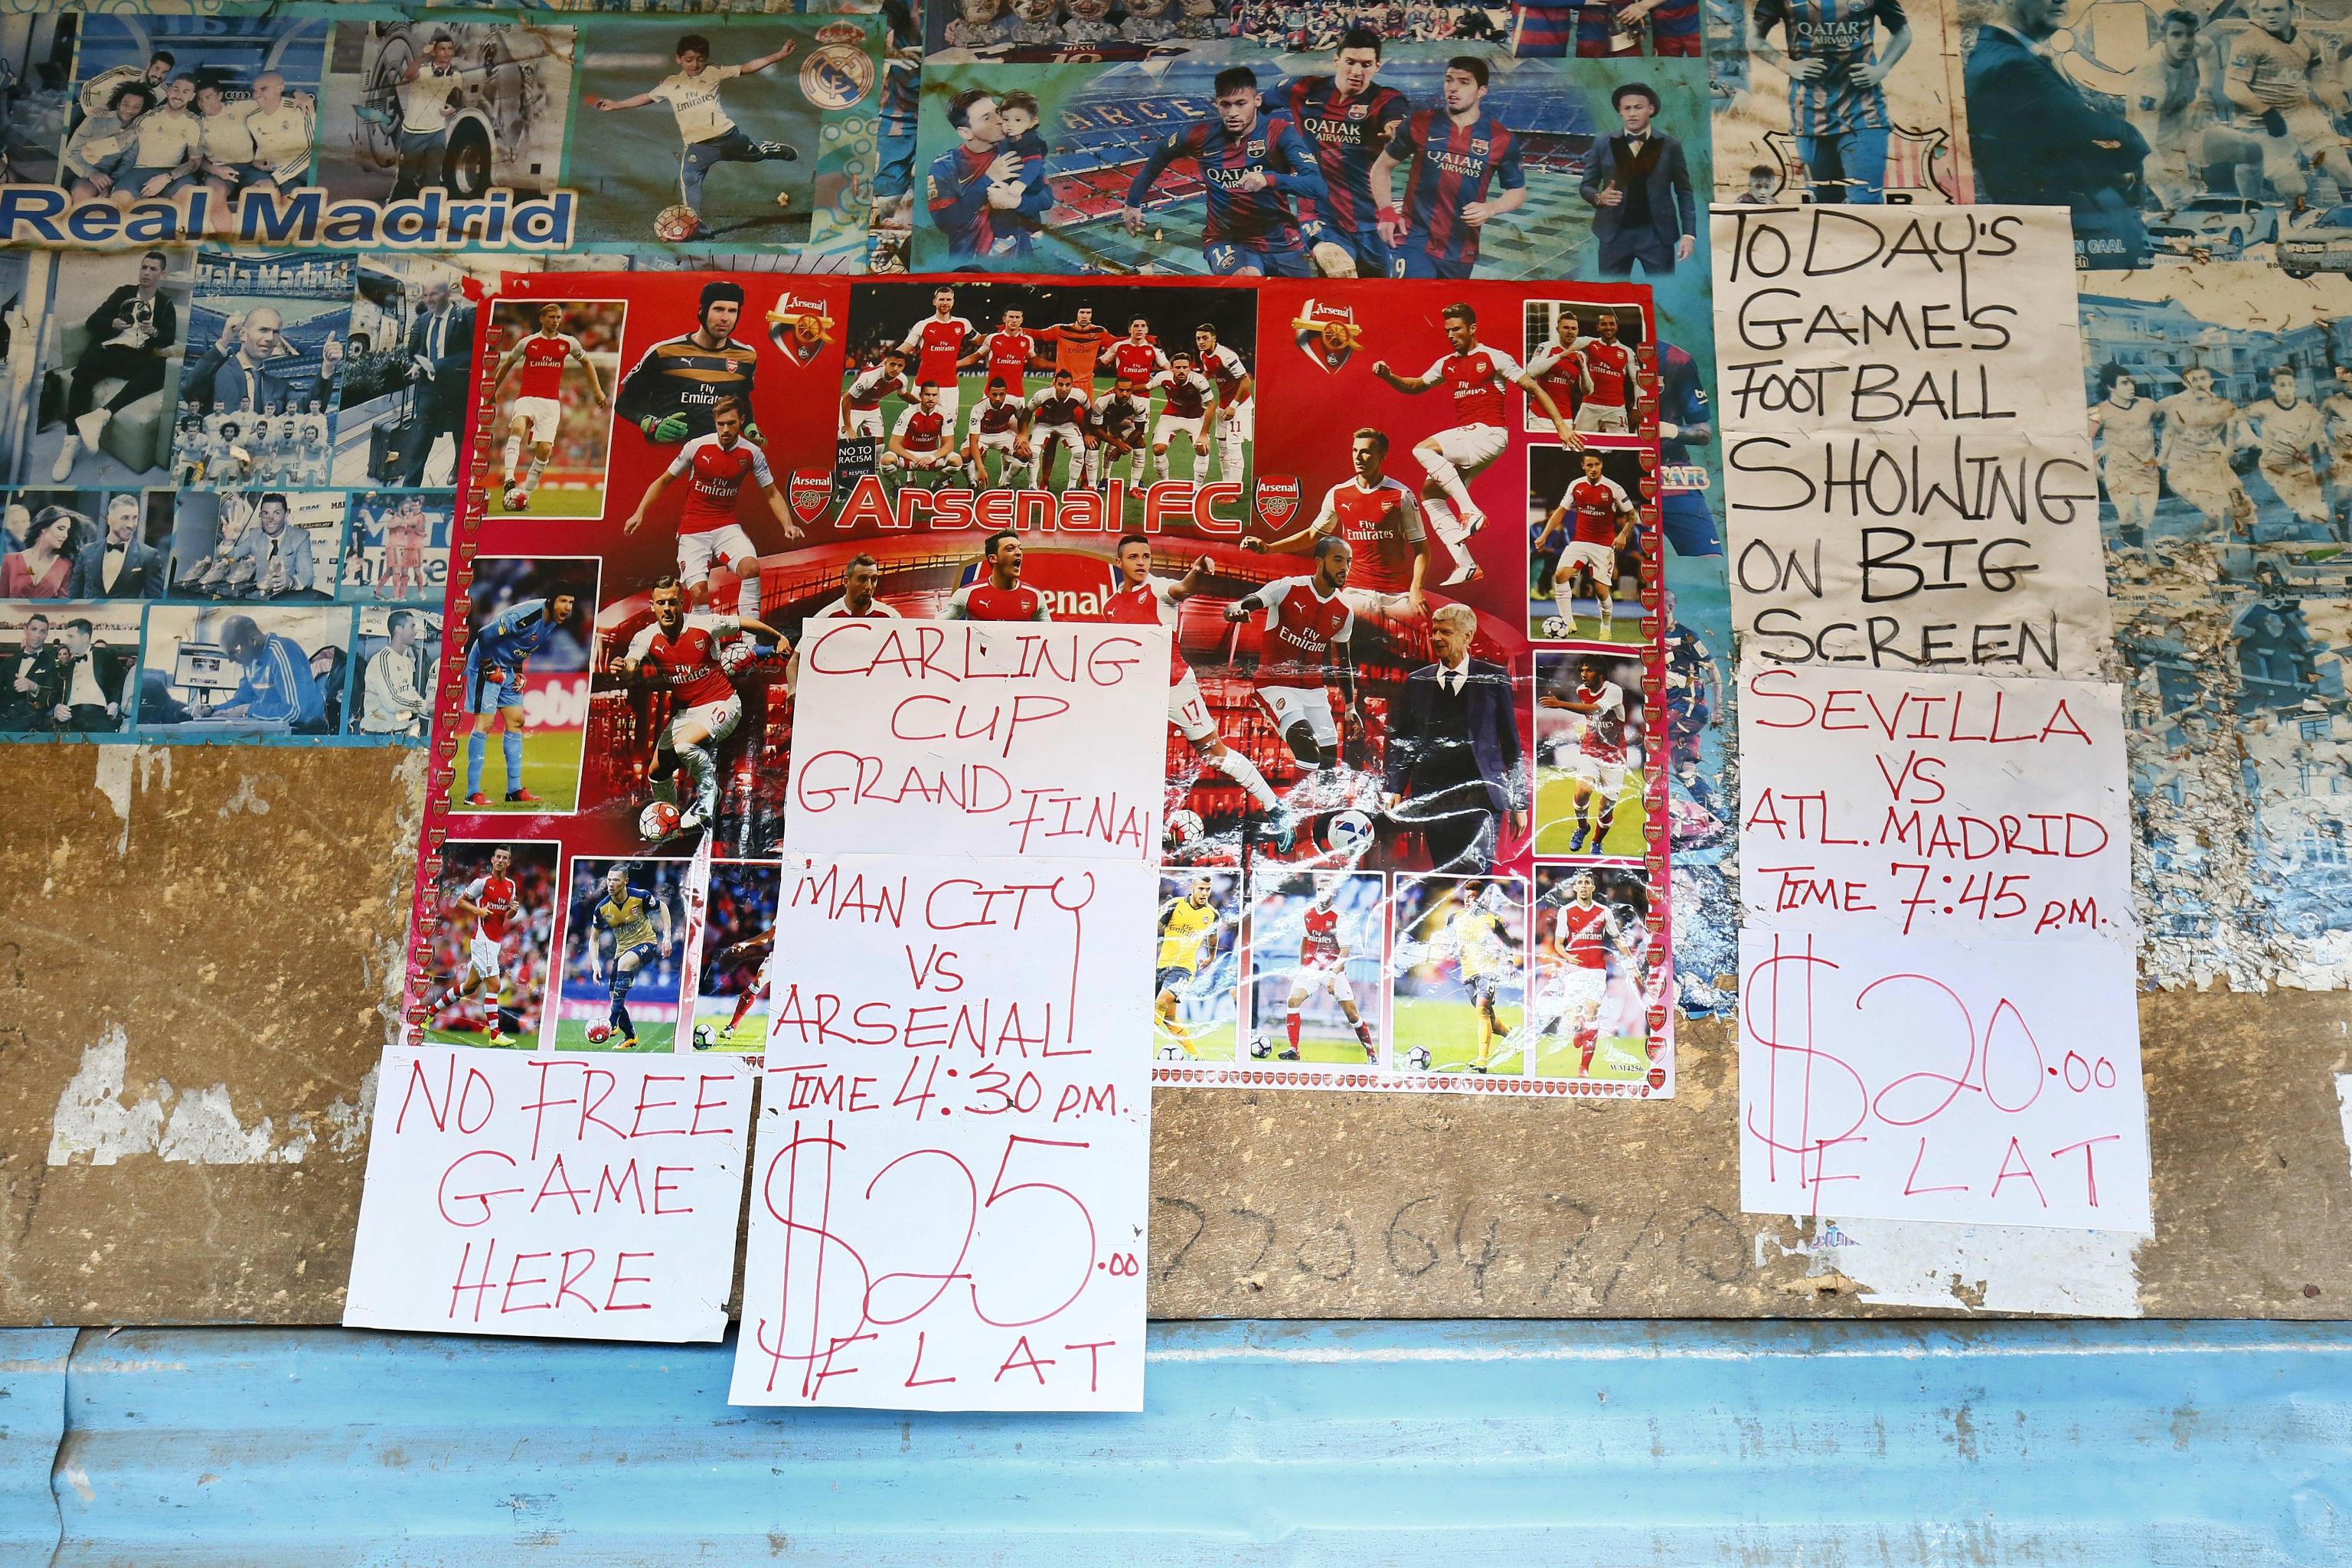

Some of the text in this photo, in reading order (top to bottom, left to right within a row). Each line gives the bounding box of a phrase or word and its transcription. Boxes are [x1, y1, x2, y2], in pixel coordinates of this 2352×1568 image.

[1798, 21, 1860, 35] QATAR
[1063, 43, 1096, 51] MESSI
[1813, 34, 1860, 45] AIRWAYS
[1303, 119, 1361, 136] QATAR
[1315, 132, 1361, 145] AIRWAYS
[1426, 149, 1483, 171] QATAR
[1437, 162, 1481, 178] AIRWAYS
[2, 187, 573, 247] Real Madrid
[1394, 258, 1407, 276] 9
[786, 296, 823, 312] Arsenal
[1312, 302, 1350, 318] Arsenal
[1739, 287, 2017, 350] GAMES
[996, 358, 1021, 366] Emirates
[681, 391, 723, 405] Emirat
[701, 384, 715, 394] Fly
[1230, 420, 1242, 433] 11
[838, 446, 872, 456] NO TO
[838, 455, 872, 464] RACISM
[694, 480, 738, 497] Emirates
[713, 477, 728, 487] Fly
[793, 476, 831, 487] Arsenal
[1258, 482, 1296, 493] Arsenal
[1730, 436, 2096, 524] SHOWING
[835, 474, 1244, 534] Arsenal FC
[1346, 528, 1394, 541] Emirates
[1359, 520, 1376, 531] Fly
[1738, 528, 2039, 603] ON BIG
[1302, 626, 1321, 641] Fly
[1754, 609, 2058, 671] SCREEN
[809, 622, 1142, 686] CARLING
[663, 664, 710, 684] Emirates
[675, 664, 691, 675] Fly
[1181, 698, 1200, 723] 17
[1751, 670, 2092, 744] SEVILLA
[891, 695, 1070, 759] CUP
[798, 750, 1011, 814] GRAND
[1877, 750, 1945, 803] VS
[792, 858, 906, 928] MAN
[1758, 866, 1877, 913] TIME
[1891, 862, 2030, 935] 7:45
[906, 943, 963, 992] VS
[773, 984, 1091, 1058] ARSENAL
[1610, 1064, 1643, 1073] WM4256
[1746, 933, 2117, 1188] $20.00
[768, 1063, 879, 1112] TIME
[893, 1055, 1041, 1120] 4:30
[397, 1054, 735, 1161] NO FREE
[439, 1150, 694, 1227] GAME
[757, 1120, 1140, 1397] $25.00
[450, 1238, 655, 1322] HERE
